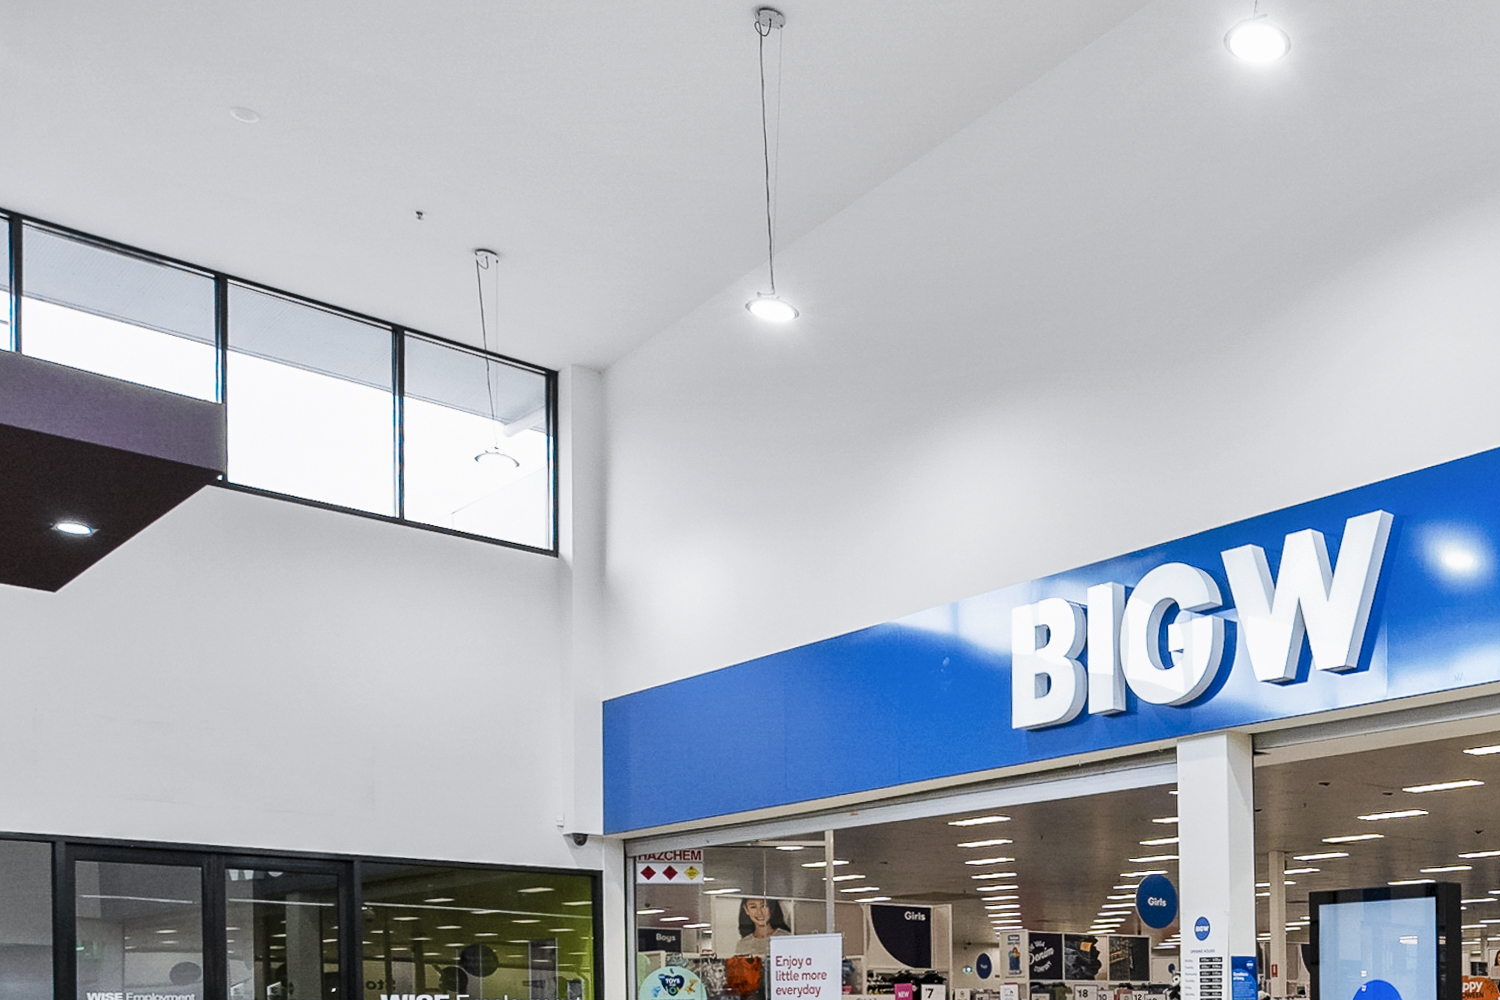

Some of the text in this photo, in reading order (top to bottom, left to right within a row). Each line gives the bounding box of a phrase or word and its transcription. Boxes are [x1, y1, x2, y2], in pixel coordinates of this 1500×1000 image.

[1147, 896, 1167, 906] Girls
[904, 911, 926, 921] Girls
[656, 933, 676, 942] Boys
[776, 956, 803, 969] Enjoy
[776, 970, 827, 981] little more
[776, 984, 821, 998] everyday
[1462, 981, 1483, 992] PPY
